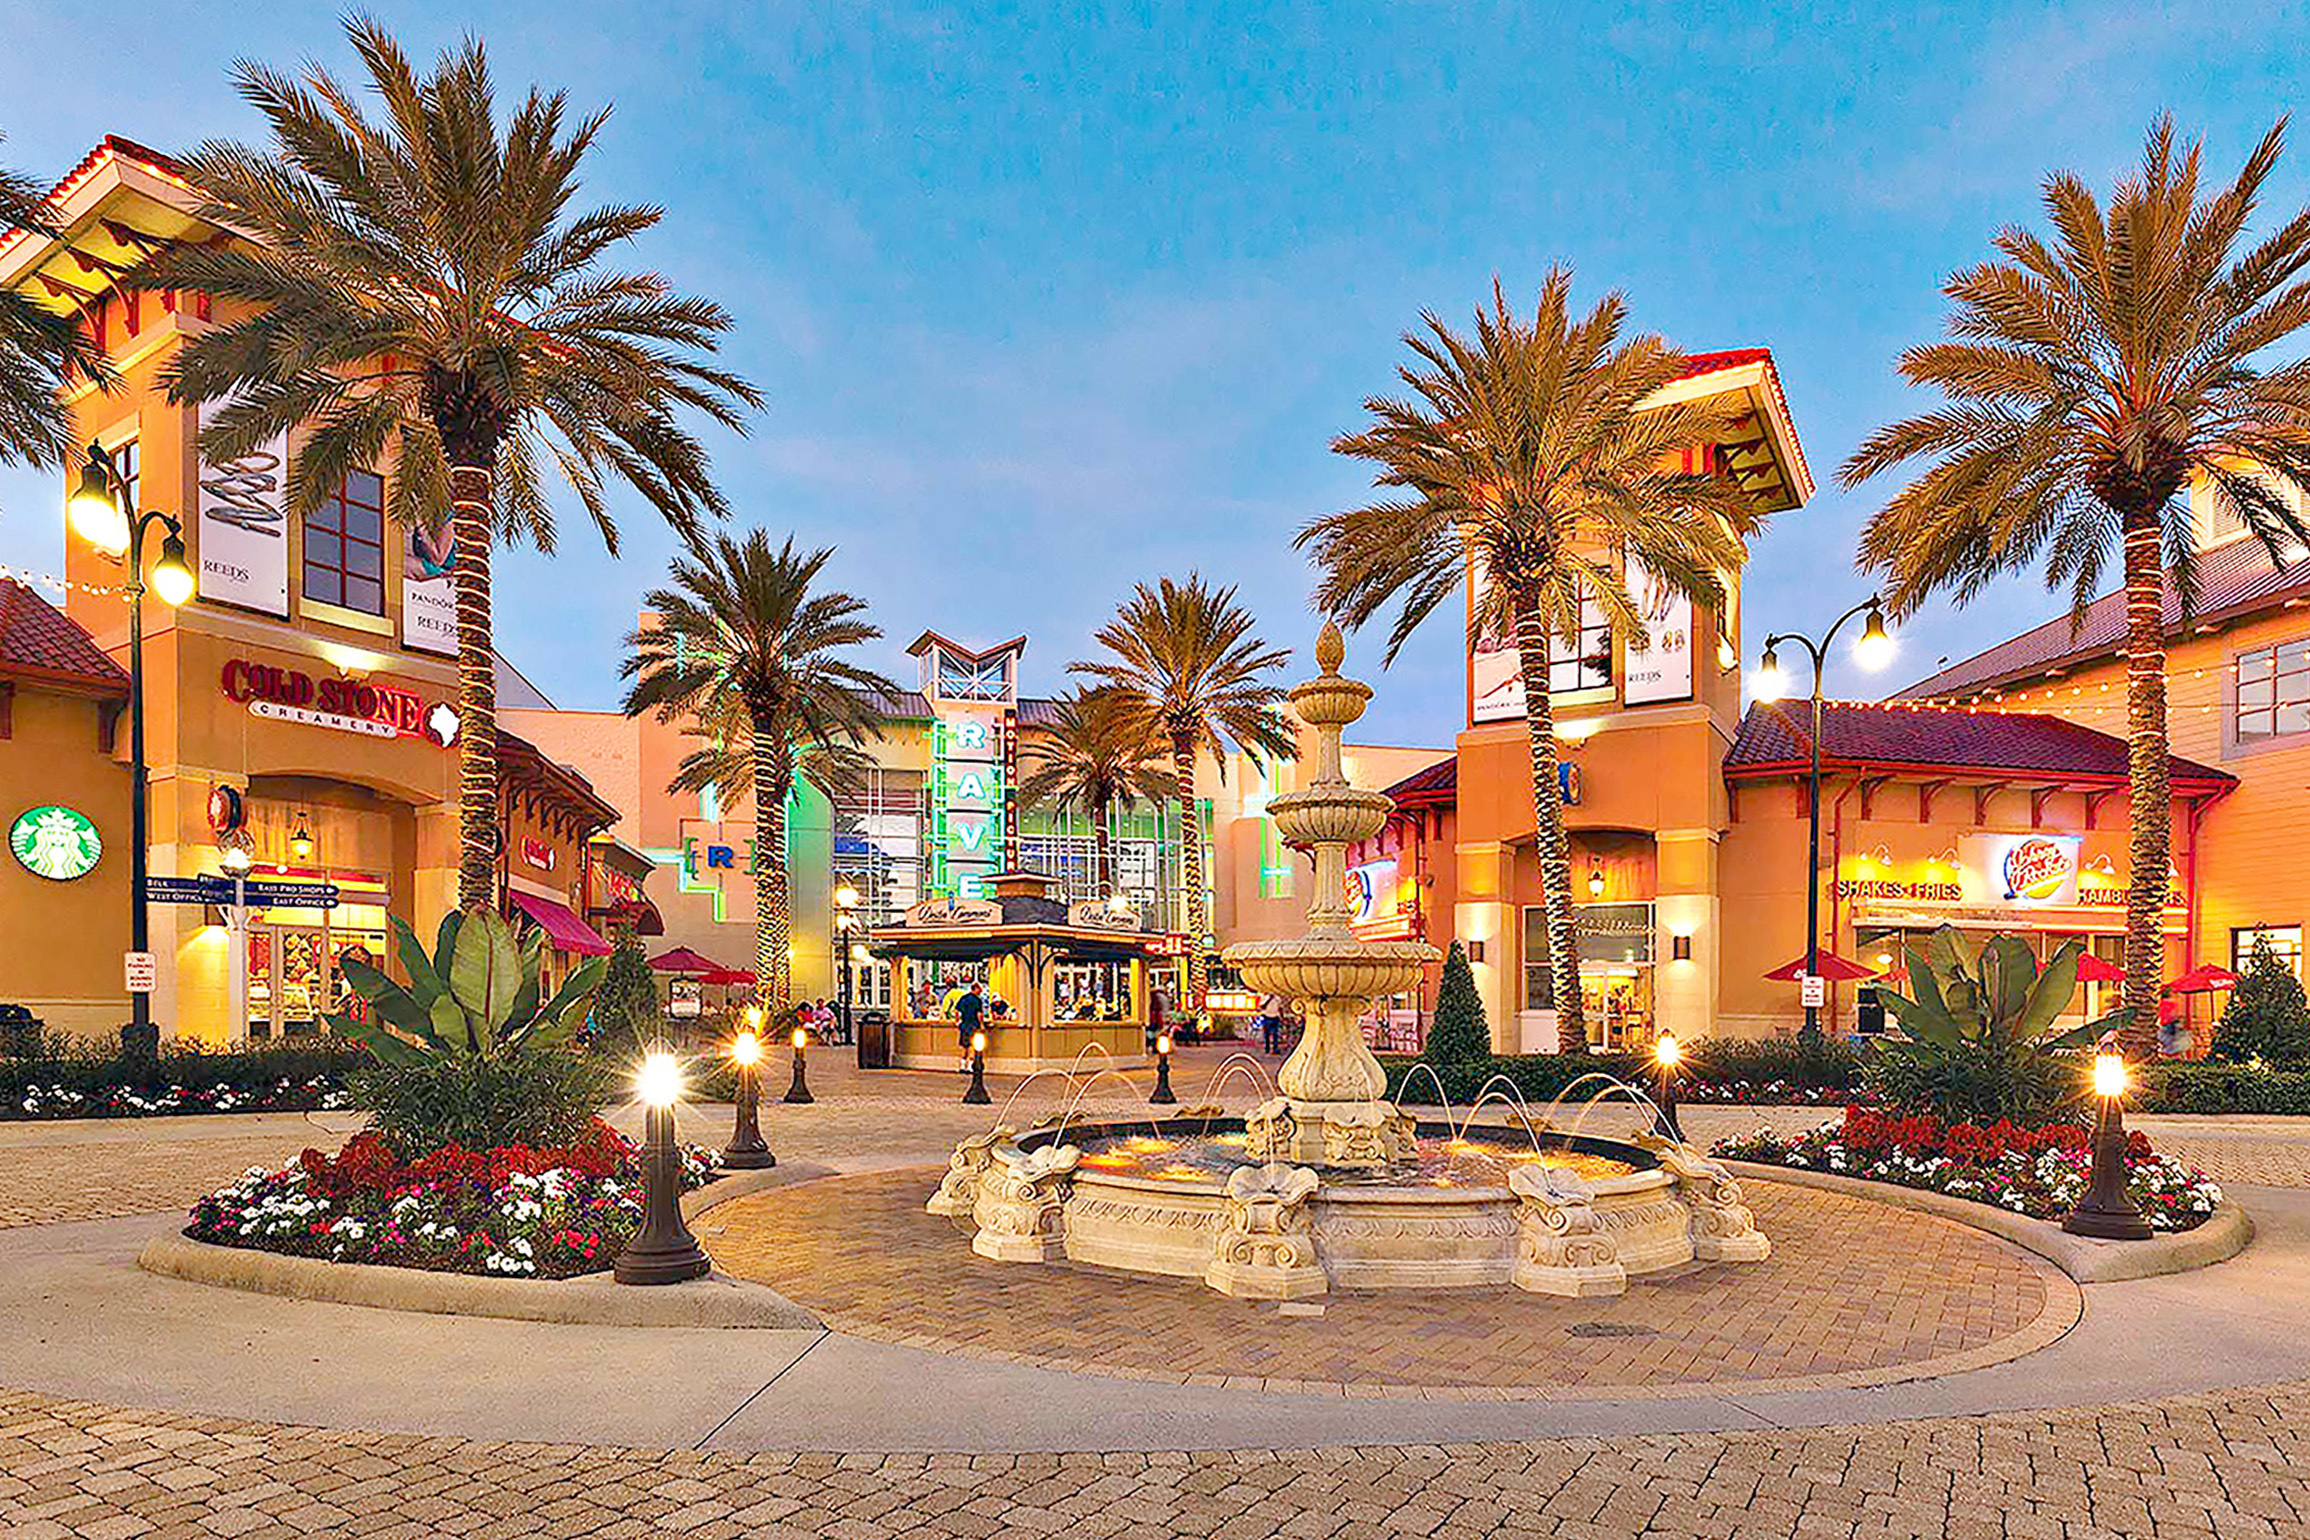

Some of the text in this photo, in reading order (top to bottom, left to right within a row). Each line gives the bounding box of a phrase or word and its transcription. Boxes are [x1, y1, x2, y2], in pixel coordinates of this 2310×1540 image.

[204, 560, 249, 580] REEDS
[418, 616, 456, 633] REED
[222, 659, 423, 733] COLD STONE
[259, 704, 391, 734] CREAMERY
[1005, 716, 1016, 870] MOTION PICTUR
[957, 721, 985, 898] RAVE
[708, 845, 734, 868] R
[1838, 880, 1962, 901] SHAKES FRIES
